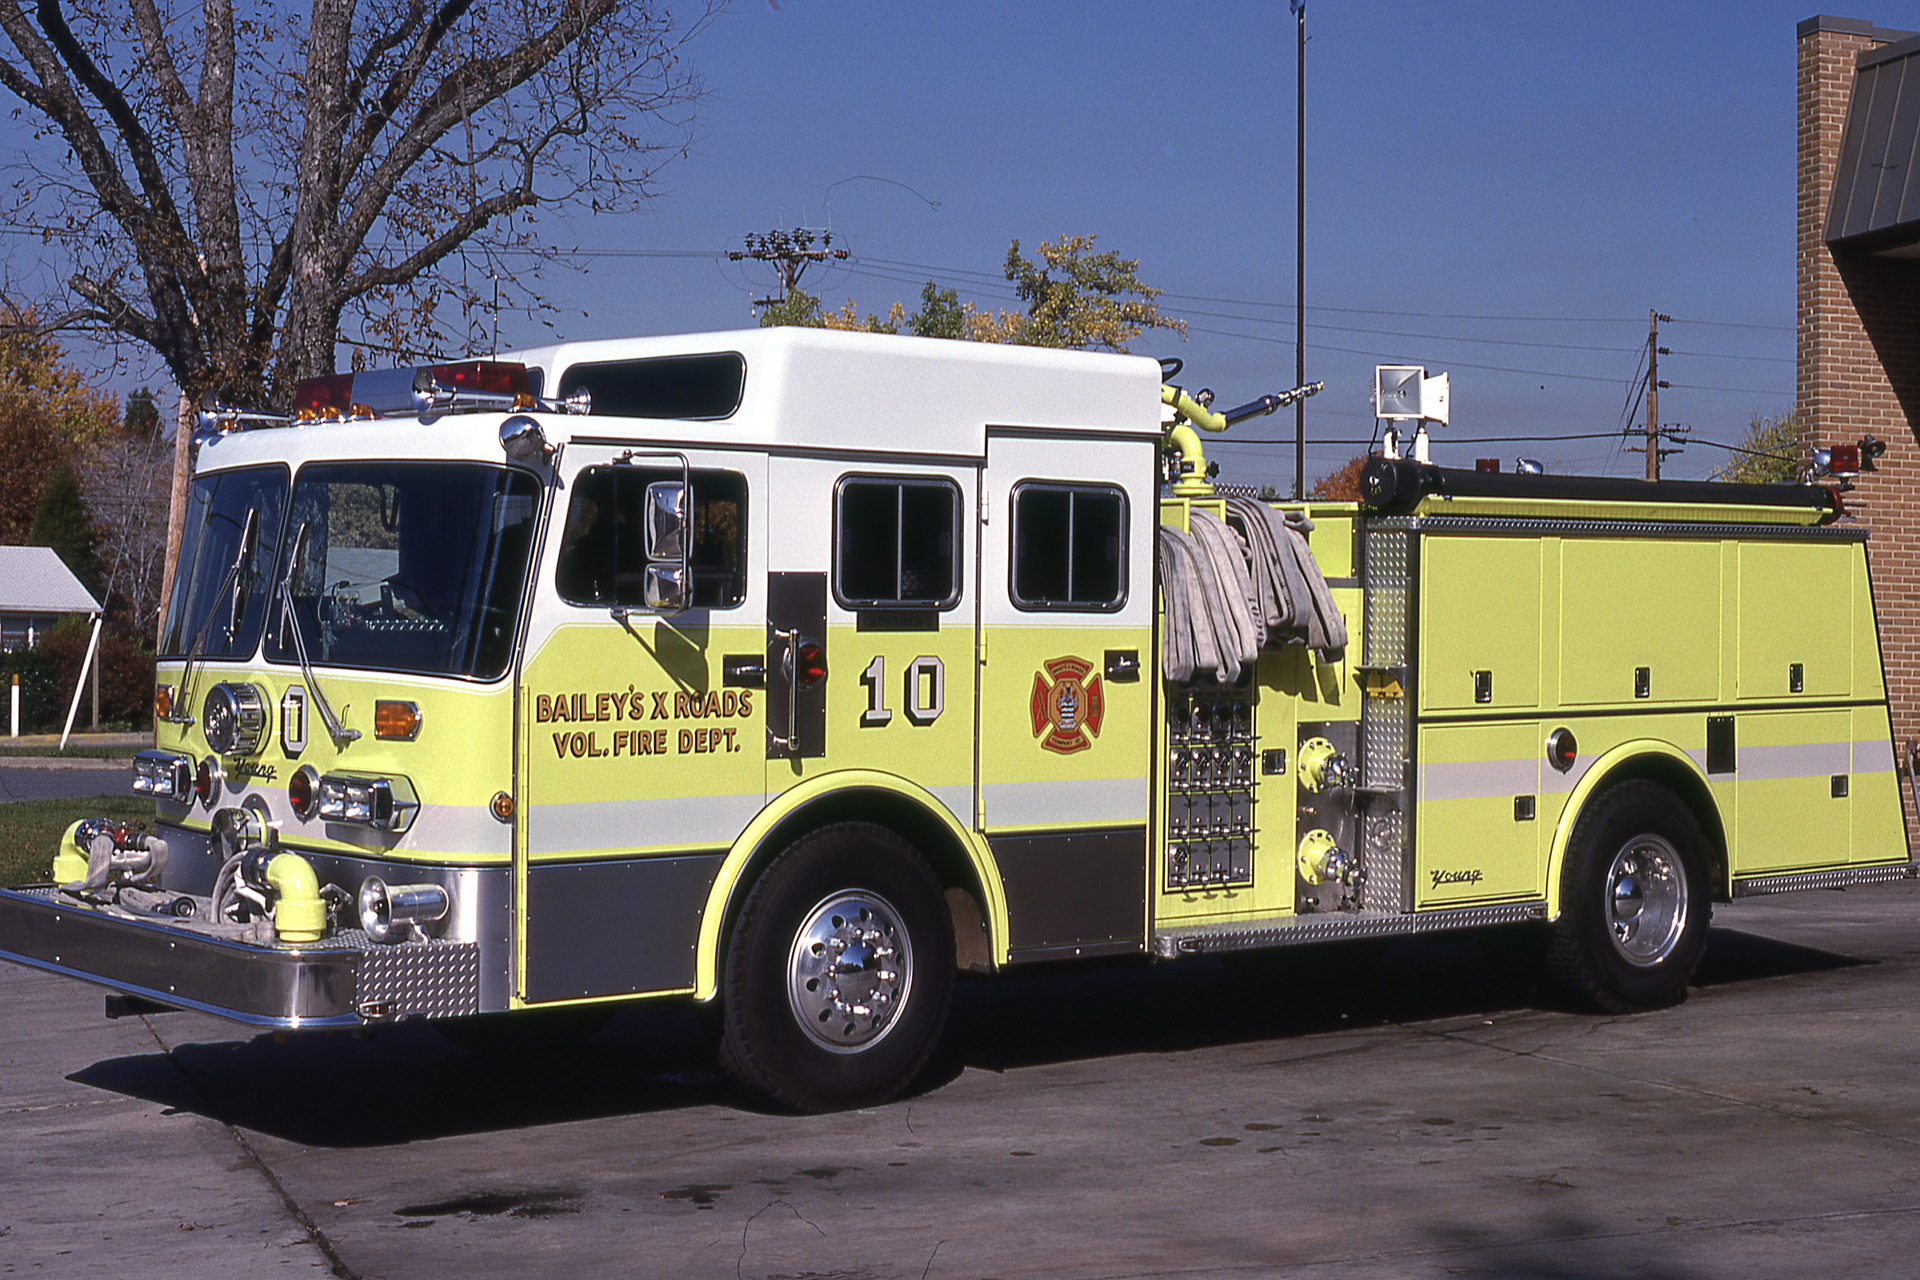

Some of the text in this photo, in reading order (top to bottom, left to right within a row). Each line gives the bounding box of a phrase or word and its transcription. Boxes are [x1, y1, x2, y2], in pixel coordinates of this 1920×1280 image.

[536, 684, 753, 722] BAILEY'S X ROADS
[859, 655, 945, 728] 10
[552, 728, 741, 759] VOL. FIRE DEPT.
[233, 756, 278, 784] Young
[1430, 869, 1483, 890] Young
